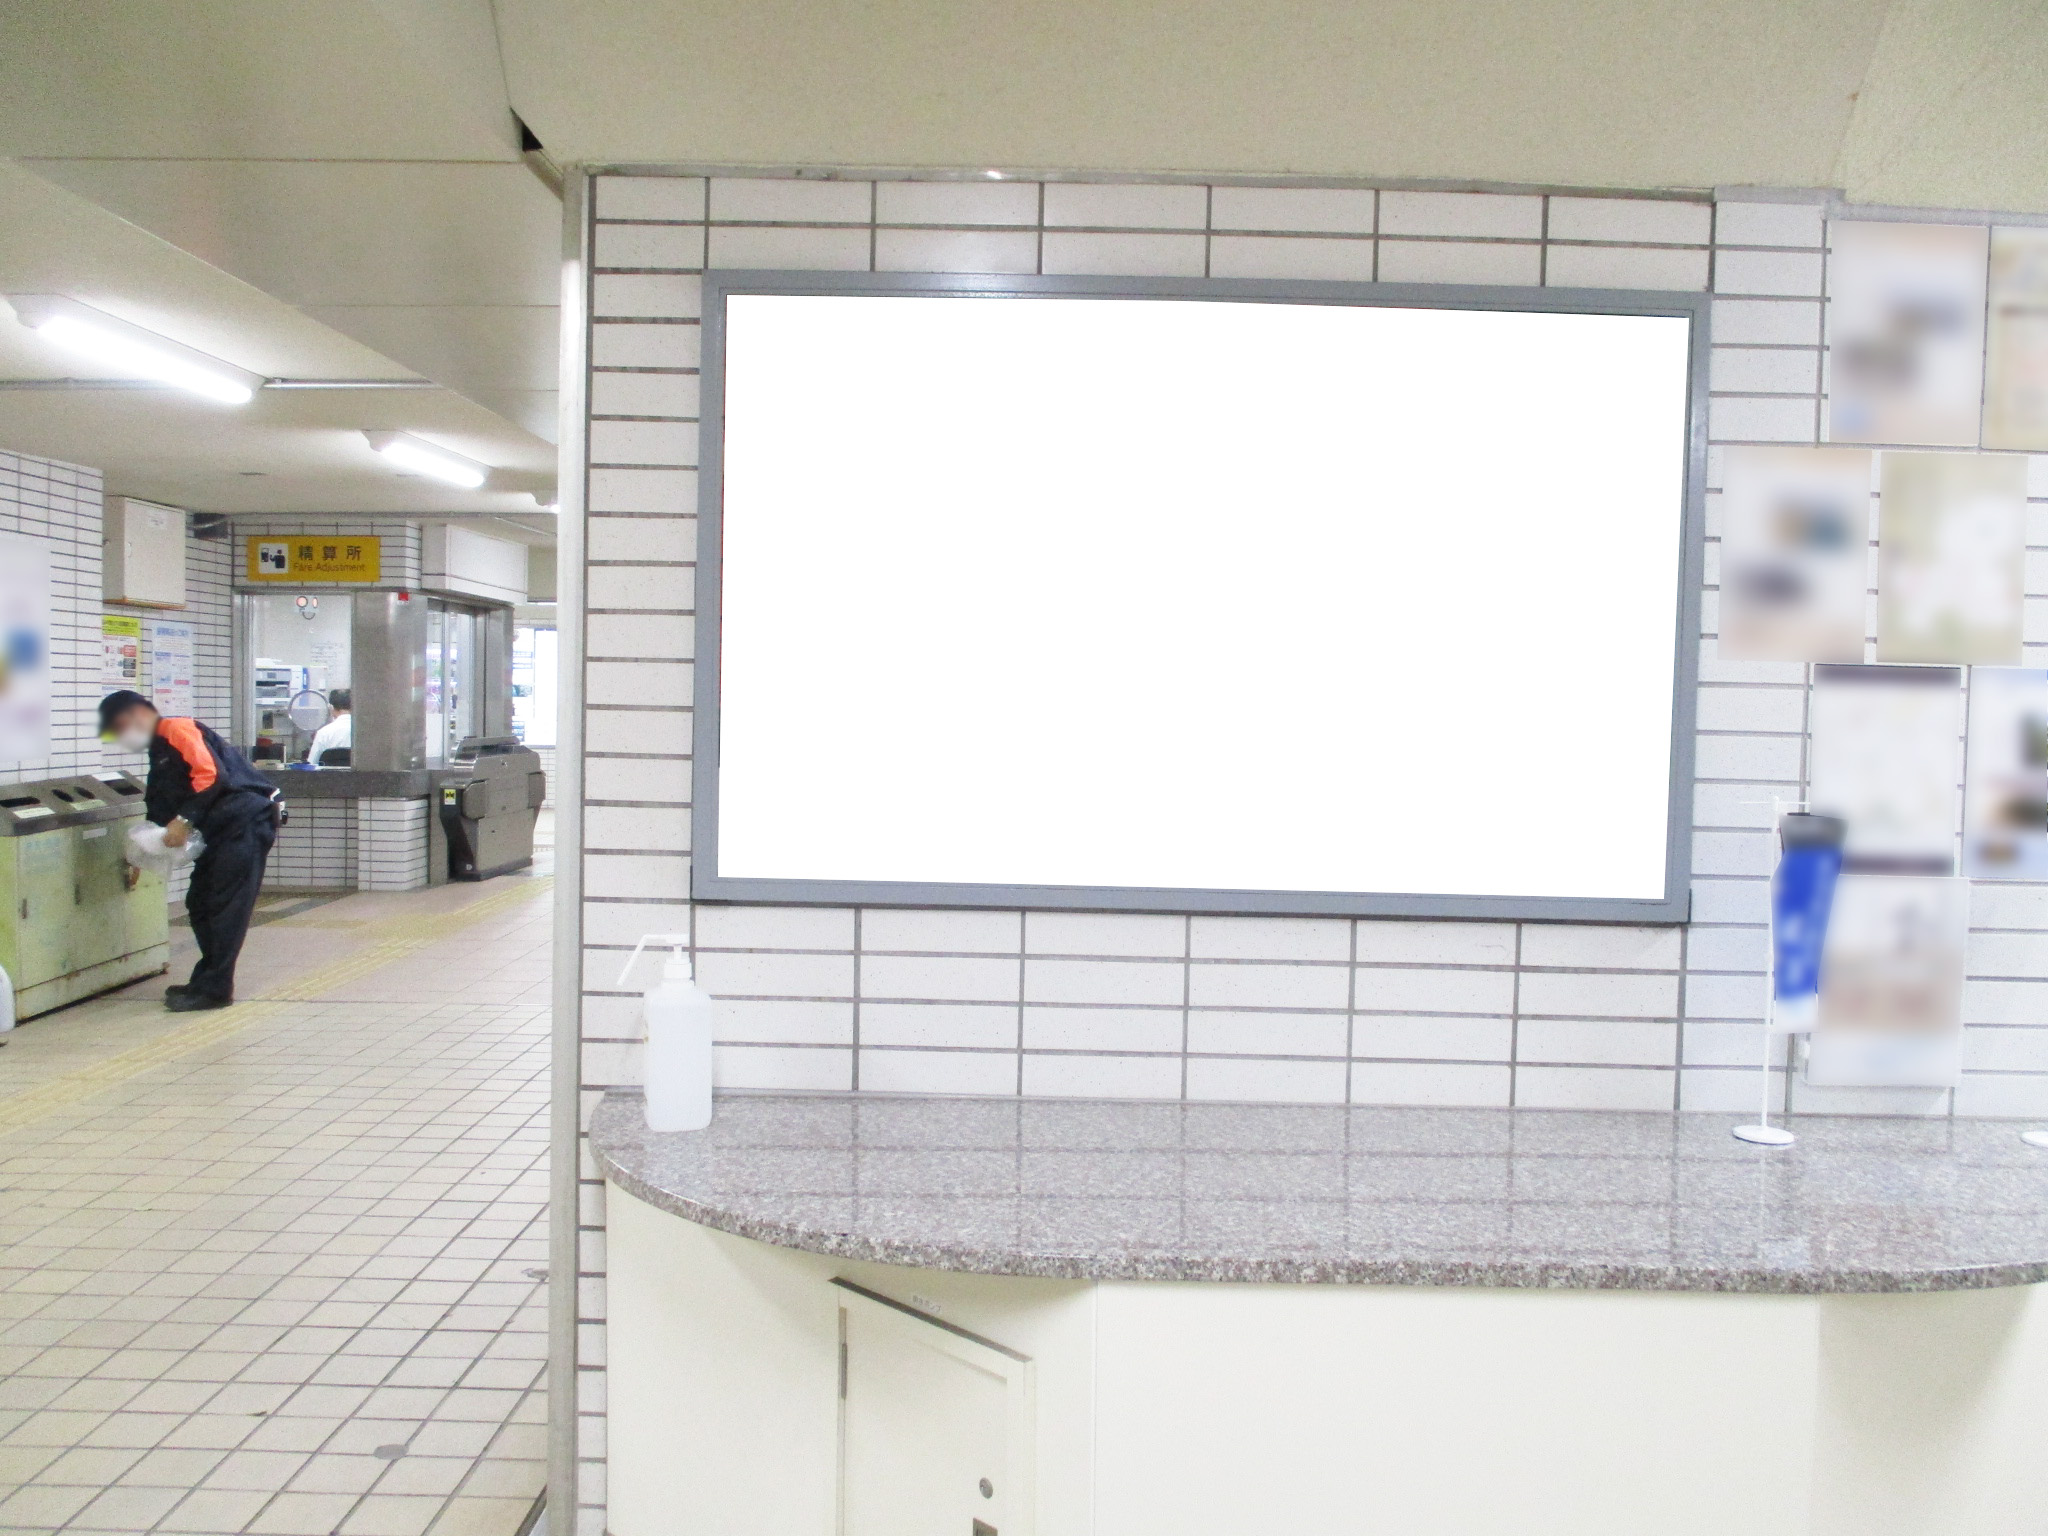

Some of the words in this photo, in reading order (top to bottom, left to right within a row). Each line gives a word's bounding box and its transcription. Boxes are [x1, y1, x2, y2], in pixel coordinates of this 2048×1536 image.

[298, 545, 361, 561] 精算所
[294, 562, 313, 572] Fare
[315, 562, 365, 573] Adjustment
